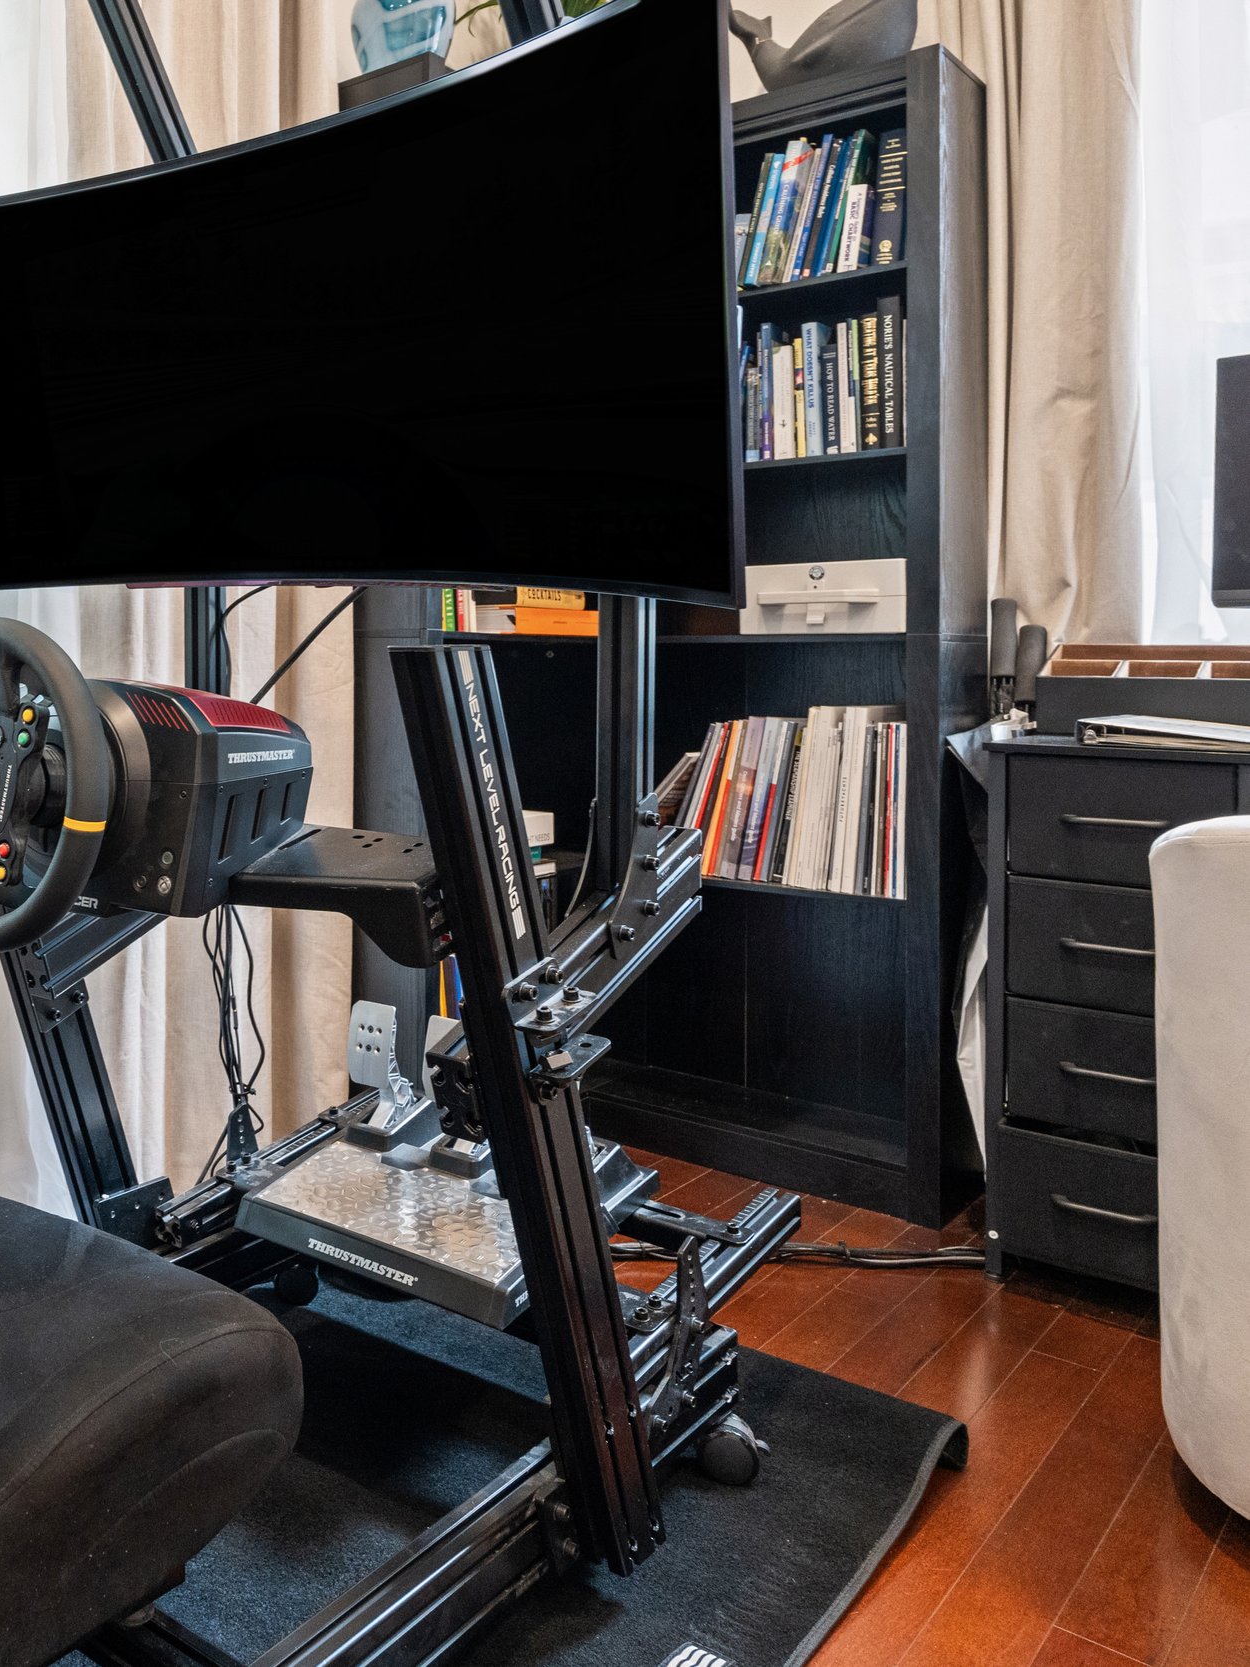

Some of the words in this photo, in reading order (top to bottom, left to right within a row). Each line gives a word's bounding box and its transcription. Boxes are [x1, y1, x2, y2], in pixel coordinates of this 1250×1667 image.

[778, 184, 790, 216] CRUISING
[817, 206, 826, 219] Rules
[850, 201, 858, 219] BASIC
[844, 222, 854, 262] CHARTWORK
[884, 314, 894, 350] NORIE'S
[806, 352, 814, 382] DOESN'T
[826, 362, 834, 381] HOW
[884, 353, 894, 399] NAUTICAL
[826, 382, 834, 393] TO
[808, 400, 814, 409] US
[885, 401, 894, 434] TABLES
[528, 588, 561, 601] COCKTAILS
[228, 750, 294, 764] THRUSTMASTER
[0, 765, 12, 820] THRUSTMASTER
[789, 760, 799, 794] SEAMANSHIP
[465, 682, 486, 743] NEXT
[480, 749, 501, 825] LEVEL
[496, 825, 520, 913] RACING
[785, 794, 795, 820] EXAMINER
[308, 1238, 415, 1286] THRUSTMASTER
